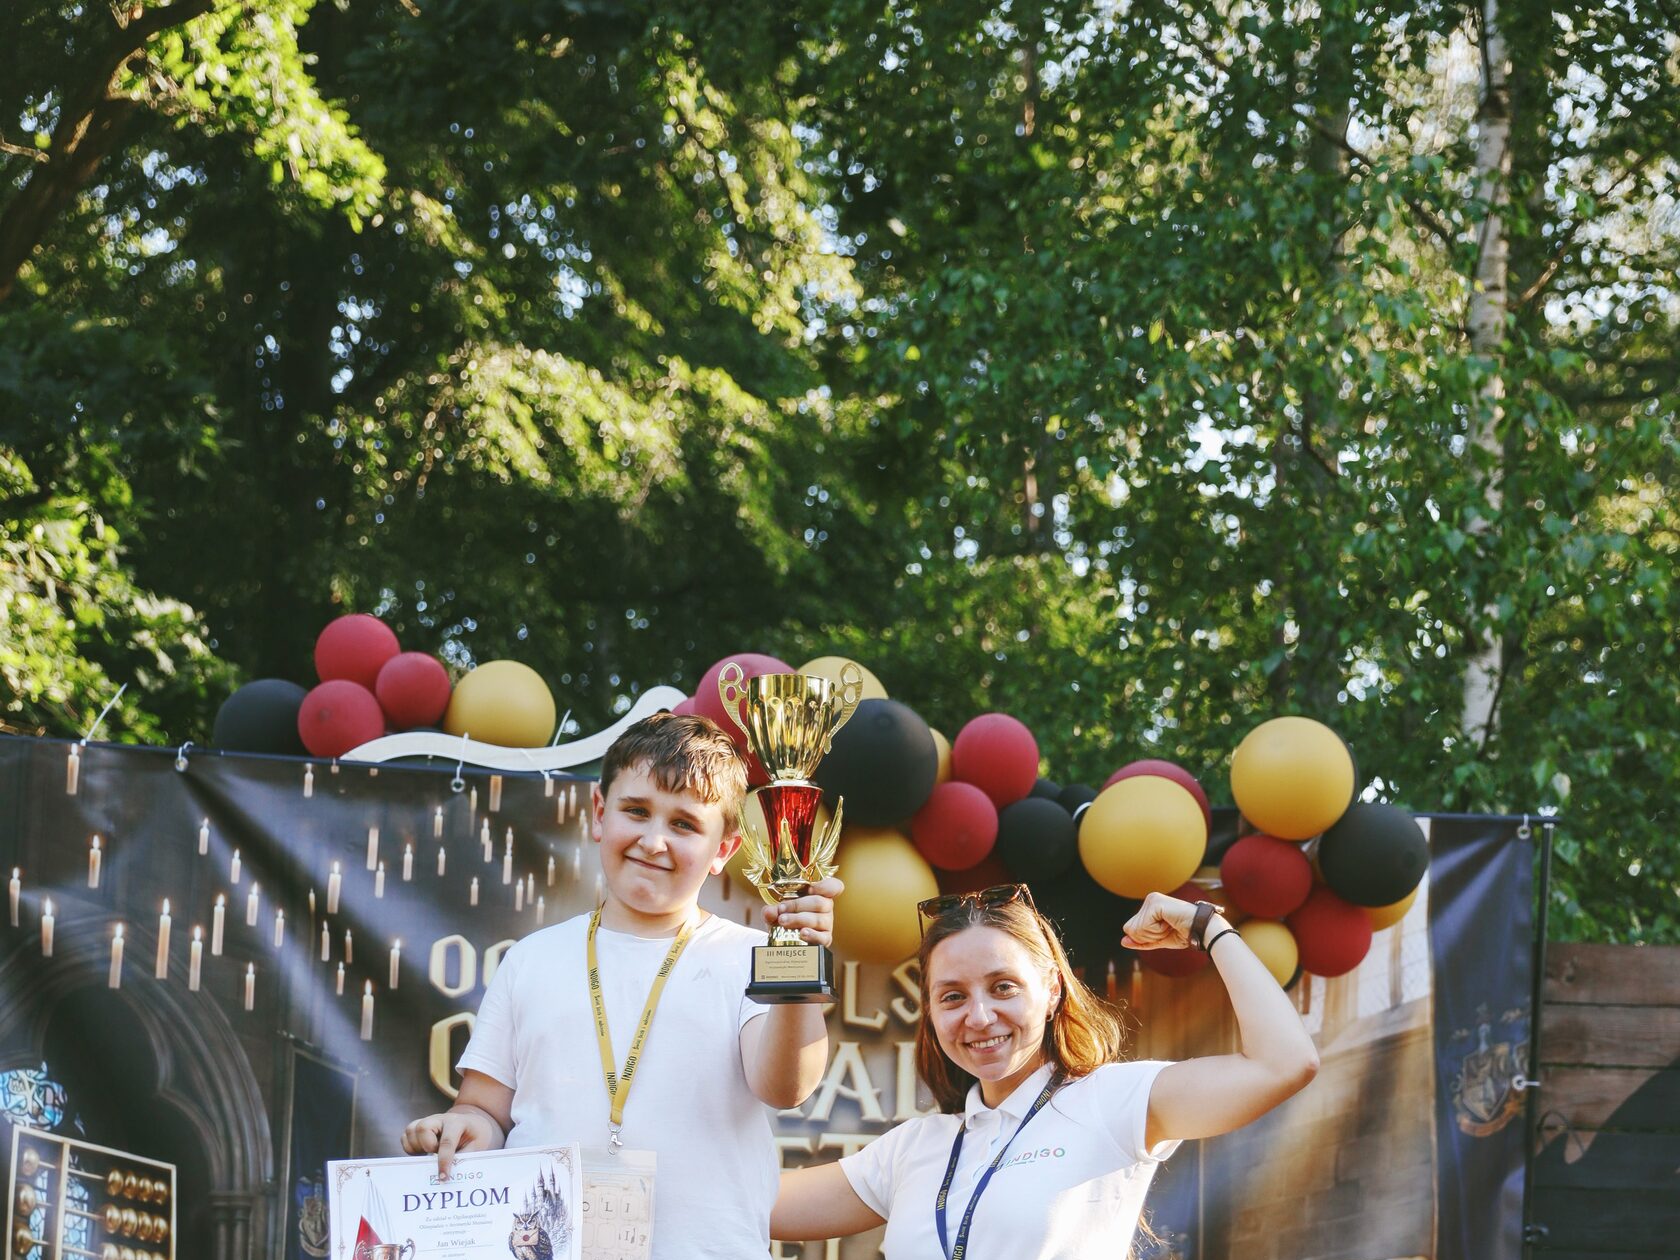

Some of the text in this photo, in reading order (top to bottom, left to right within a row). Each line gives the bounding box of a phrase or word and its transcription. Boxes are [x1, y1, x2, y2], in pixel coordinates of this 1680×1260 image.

[776, 949, 807, 958] MIEJSCE
[621, 1055, 637, 1081] INDIGO
[403, 1186, 511, 1212] DYPLOM
